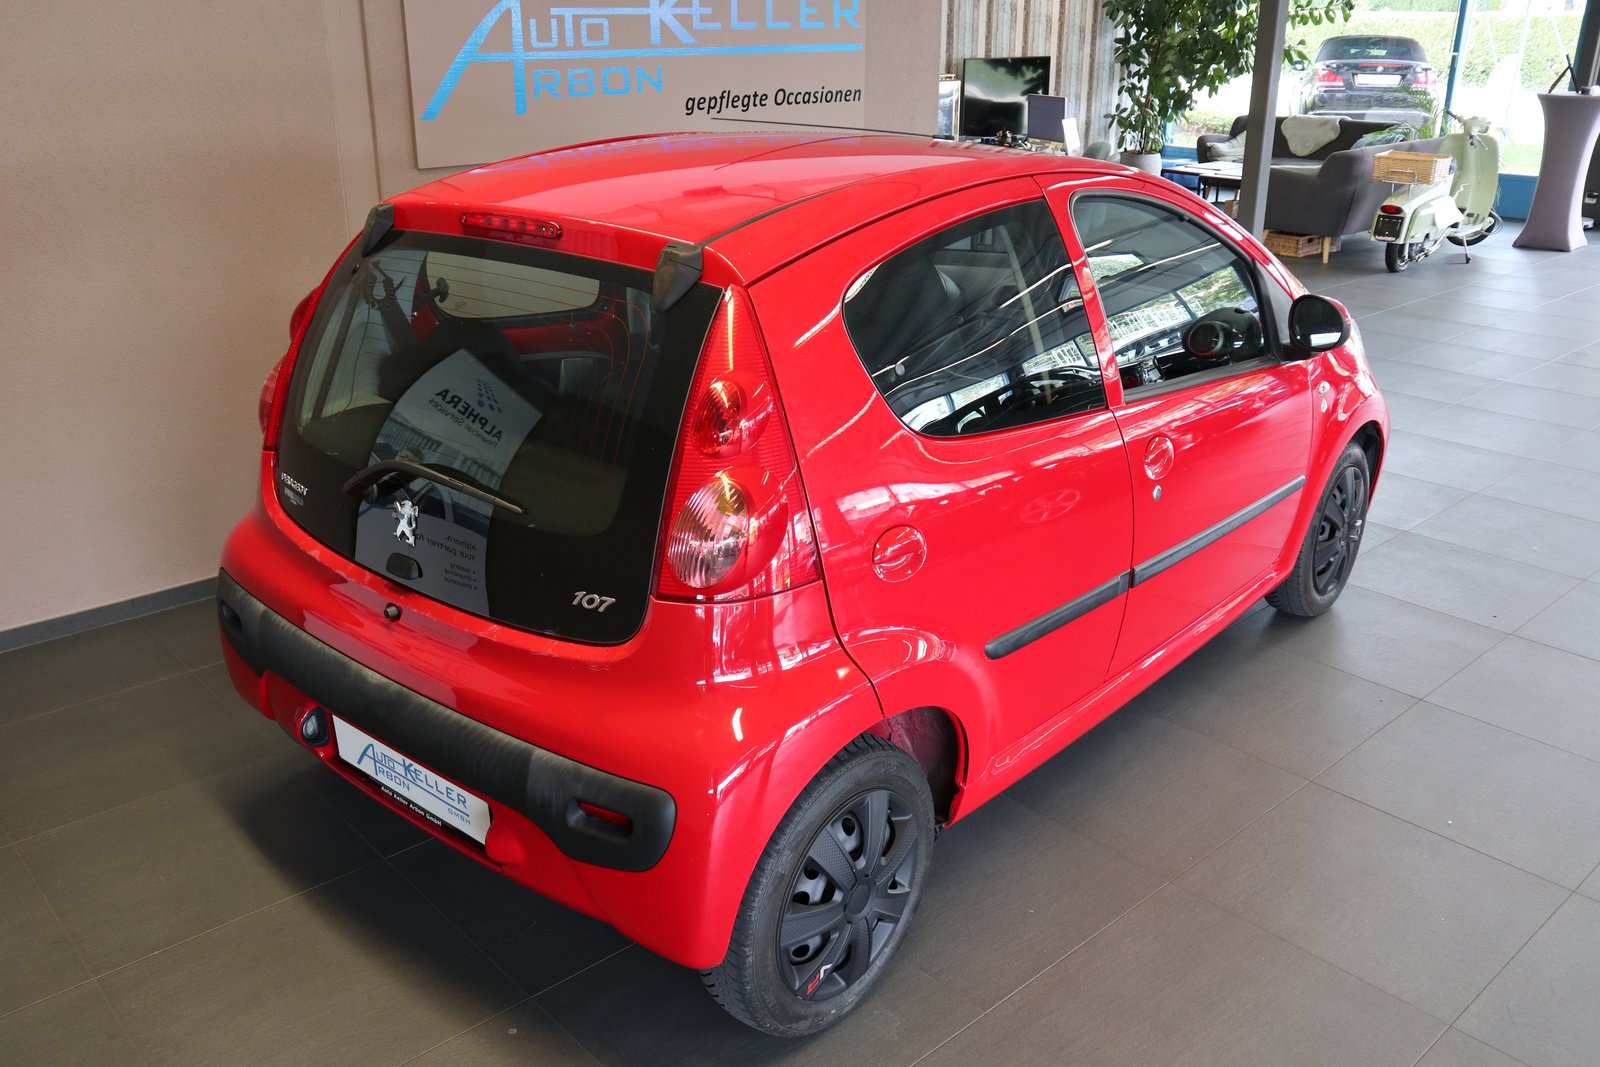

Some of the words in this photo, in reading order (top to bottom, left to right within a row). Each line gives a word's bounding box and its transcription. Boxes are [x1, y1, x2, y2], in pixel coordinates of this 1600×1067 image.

[650, 0, 860, 45] KELLER
[685, 90, 769, 115] gepflegte
[774, 86, 862, 106] Occasionen
[572, 591, 616, 613] 107
[402, 758, 467, 809] KELLER
